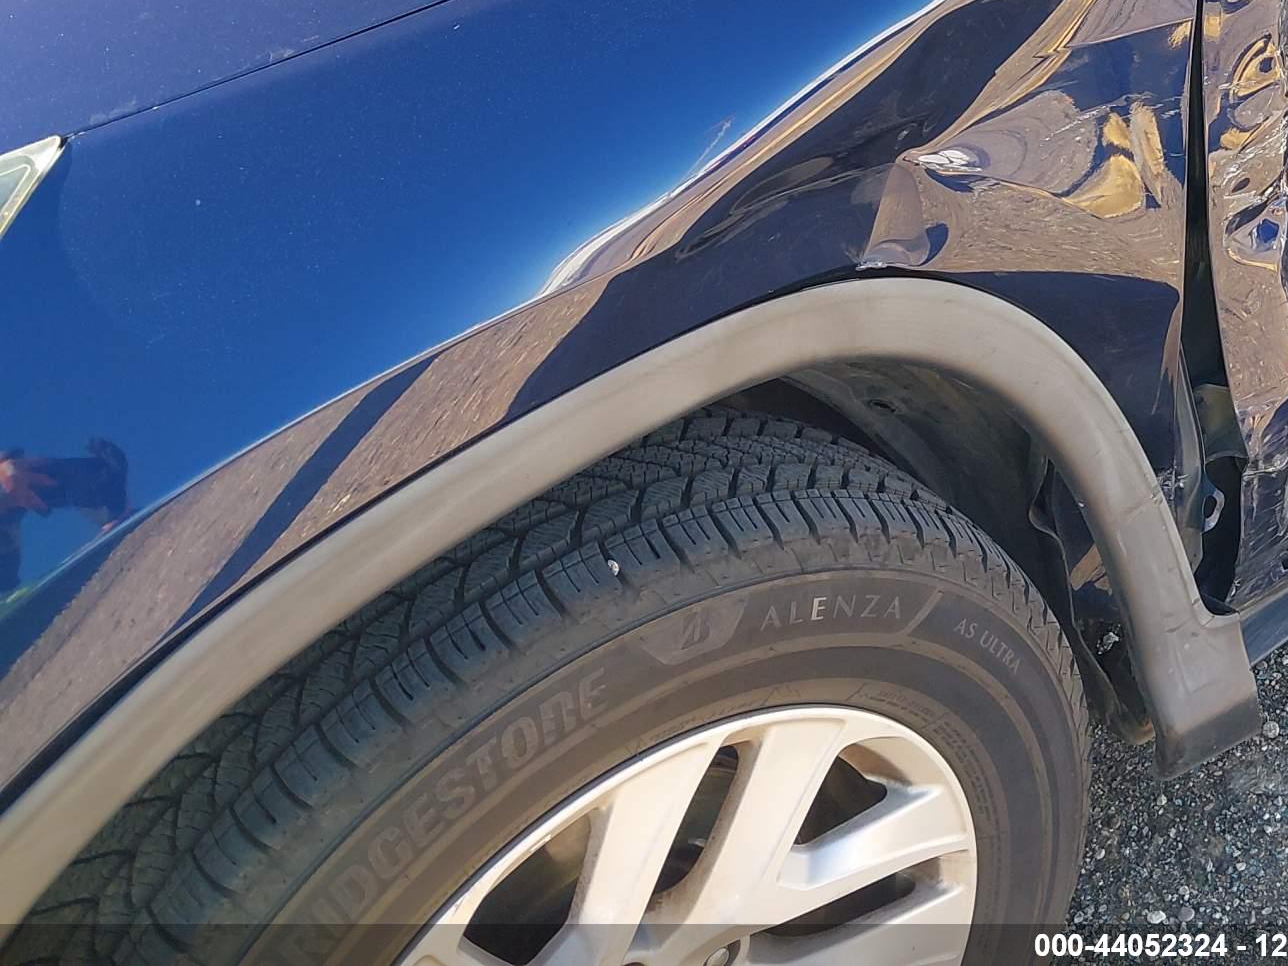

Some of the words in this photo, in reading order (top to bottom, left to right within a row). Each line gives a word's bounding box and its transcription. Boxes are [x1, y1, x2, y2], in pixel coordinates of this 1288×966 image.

[759, 593, 903, 632] ALENZA
[953, 617, 978, 640] AS
[979, 629, 1023, 675] ULTRA
[258, 666, 609, 966] RIDGESTONE
